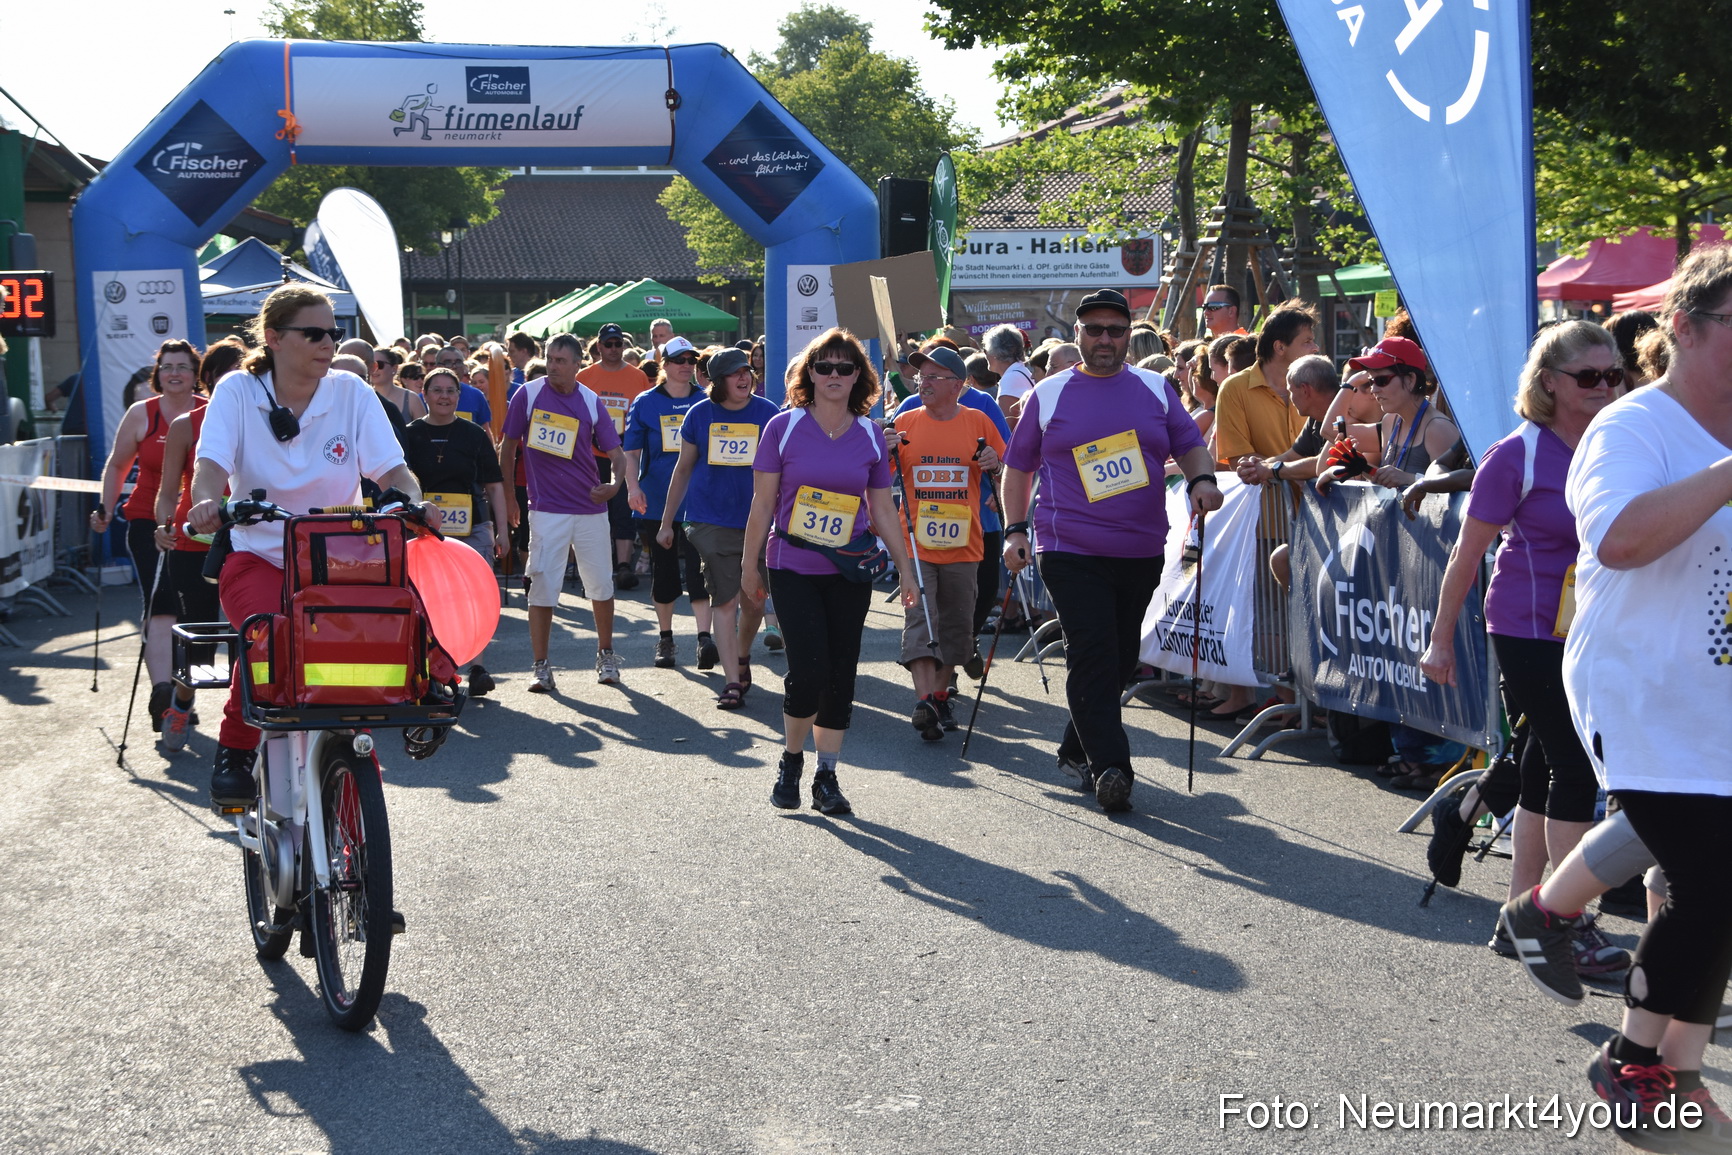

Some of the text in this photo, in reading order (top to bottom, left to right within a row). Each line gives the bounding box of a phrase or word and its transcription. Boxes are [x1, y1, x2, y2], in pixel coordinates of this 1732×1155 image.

[480, 80, 527, 90] Fischer
[444, 105, 585, 130] firmenlauf
[444, 132, 502, 140] neumarkt
[170, 155, 248, 170] Fischer
[752, 152, 771, 162] das
[755, 162, 808, 178] fährt mit!
[955, 239, 1008, 254] Jura
[1053, 263, 1073, 271] grüßt
[964, 300, 1021, 313] Willkommen
[978, 311, 1024, 321] in meinem
[538, 427, 566, 446] 310
[719, 439, 748, 454] 792
[920, 456, 960, 464] 30 Jahre
[916, 470, 965, 483] OBI
[1092, 456, 1133, 483] 300
[915, 489, 968, 499] Neumarkt
[440, 510, 467, 524] 243
[803, 511, 843, 536] 318
[926, 521, 959, 538] 610
[1335, 580, 1431, 654] Fischer
[1348, 653, 1427, 692] AUTOMOBILE
